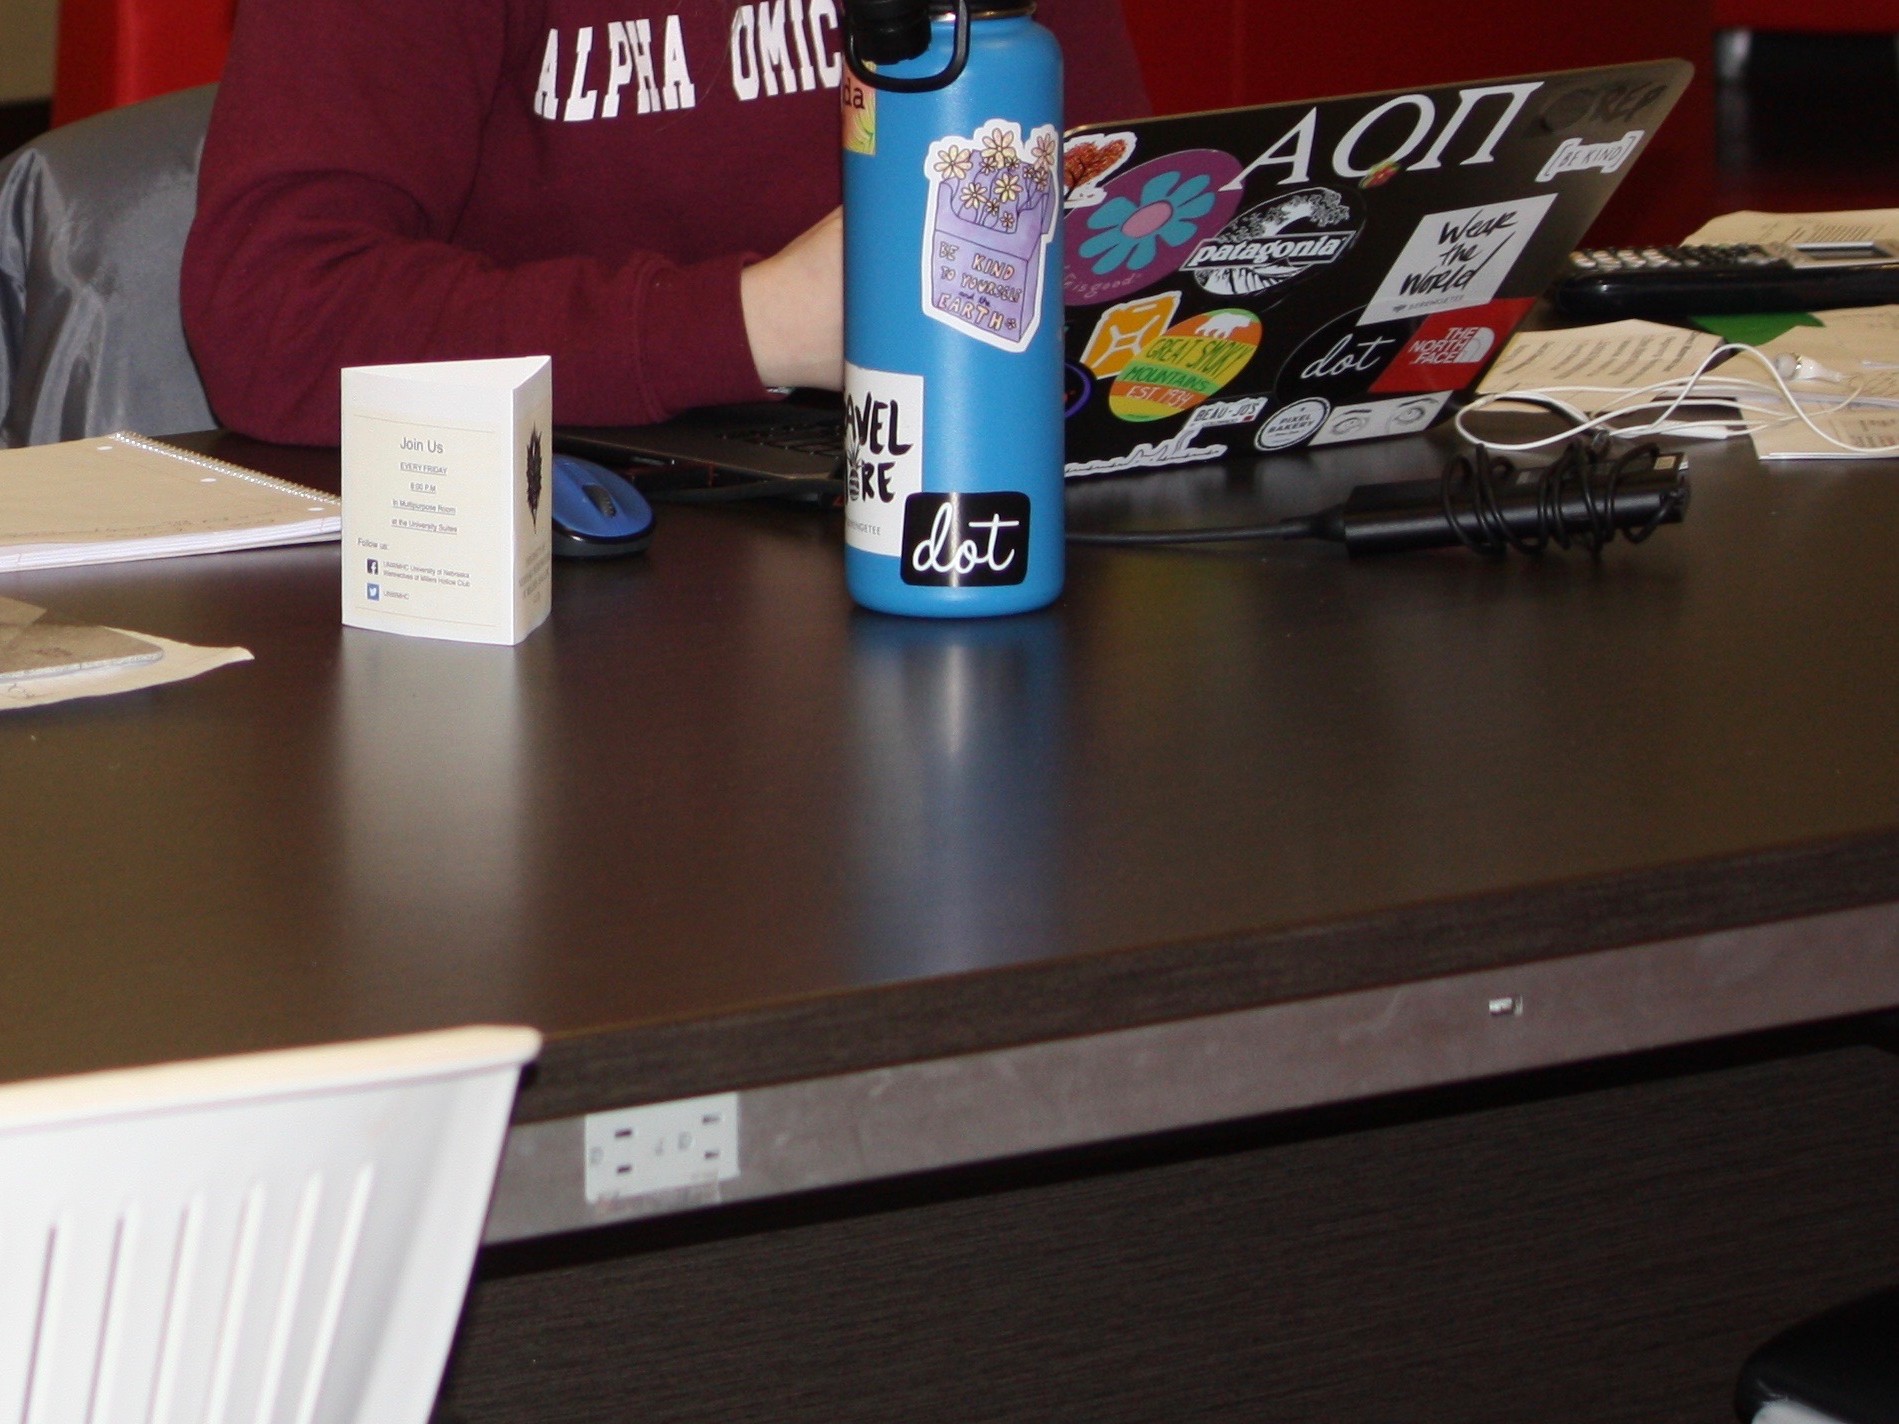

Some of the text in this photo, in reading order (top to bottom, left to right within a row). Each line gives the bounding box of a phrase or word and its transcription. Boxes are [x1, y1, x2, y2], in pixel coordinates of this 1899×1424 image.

[533, 14, 696, 121] ALPHA
[939, 241, 1015, 281] BE KIND
[1189, 236, 1339, 267] patagonia
[941, 265, 956, 282] TO
[937, 293, 1005, 331] EARTH
[1446, 327, 1479, 339] THE
[1146, 338, 1249, 379] GREAT SMOKY
[1301, 333, 1396, 378] dot
[1409, 339, 1468, 353] NORTH
[1409, 351, 1461, 365] FACE
[1123, 365, 1210, 391] MOUNTAINS
[1126, 385, 1195, 409] EST 1934
[400, 437, 443, 454] Join Us
[400, 462, 447, 474] EVERY FRIDAY
[357, 538, 377, 549] Follow
[913, 502, 1019, 574] dot
